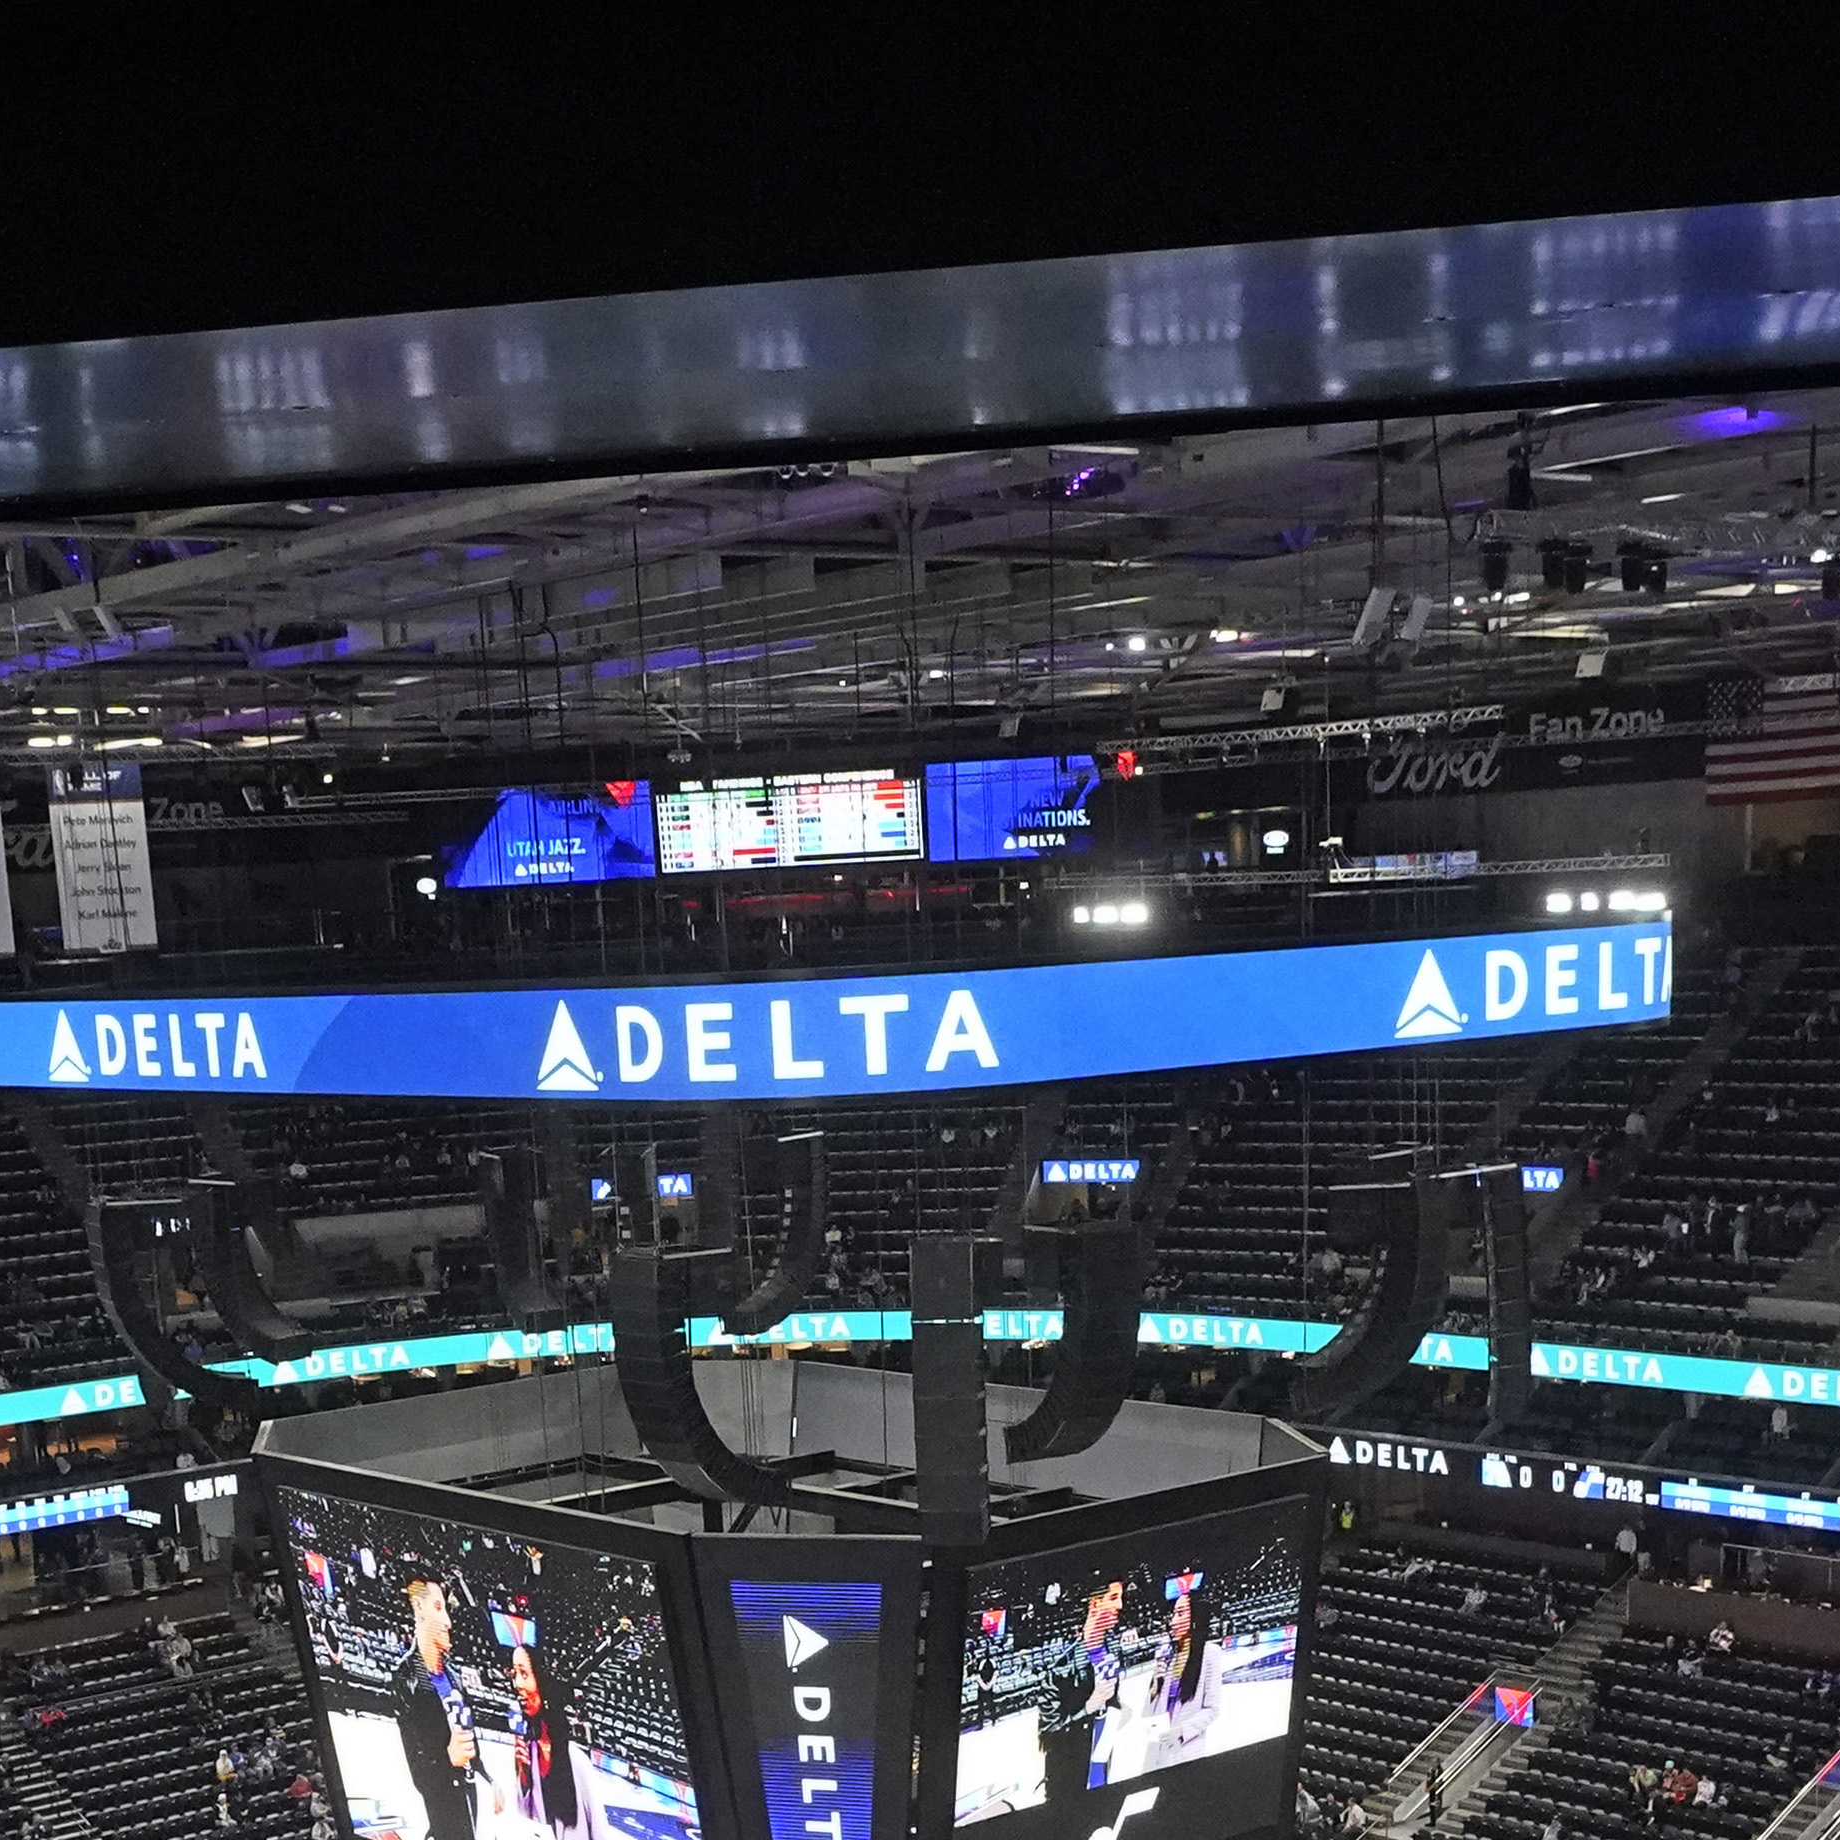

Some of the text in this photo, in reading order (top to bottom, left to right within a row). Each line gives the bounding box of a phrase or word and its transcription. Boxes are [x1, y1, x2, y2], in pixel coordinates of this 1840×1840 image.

[1528, 706, 1666, 745] Fan Zone
[1366, 731, 1508, 793] Ford
[1018, 833, 1066, 848] DELTA
[1485, 937, 1672, 1023] DELT
[97, 1010, 268, 1081] DELTA
[615, 990, 999, 1083] DELTA
[1068, 1160, 1138, 1182] DELTA
[1523, 1169, 1562, 1189] LTA
[768, 1312, 852, 1340] ELTA
[984, 1312, 1063, 1340] ELTA
[1168, 1315, 1262, 1345] DELTA
[304, 1343, 411, 1378] DELTA
[1558, 1349, 1663, 1383] DELTA
[1355, 1440, 1449, 1476] DELTA
